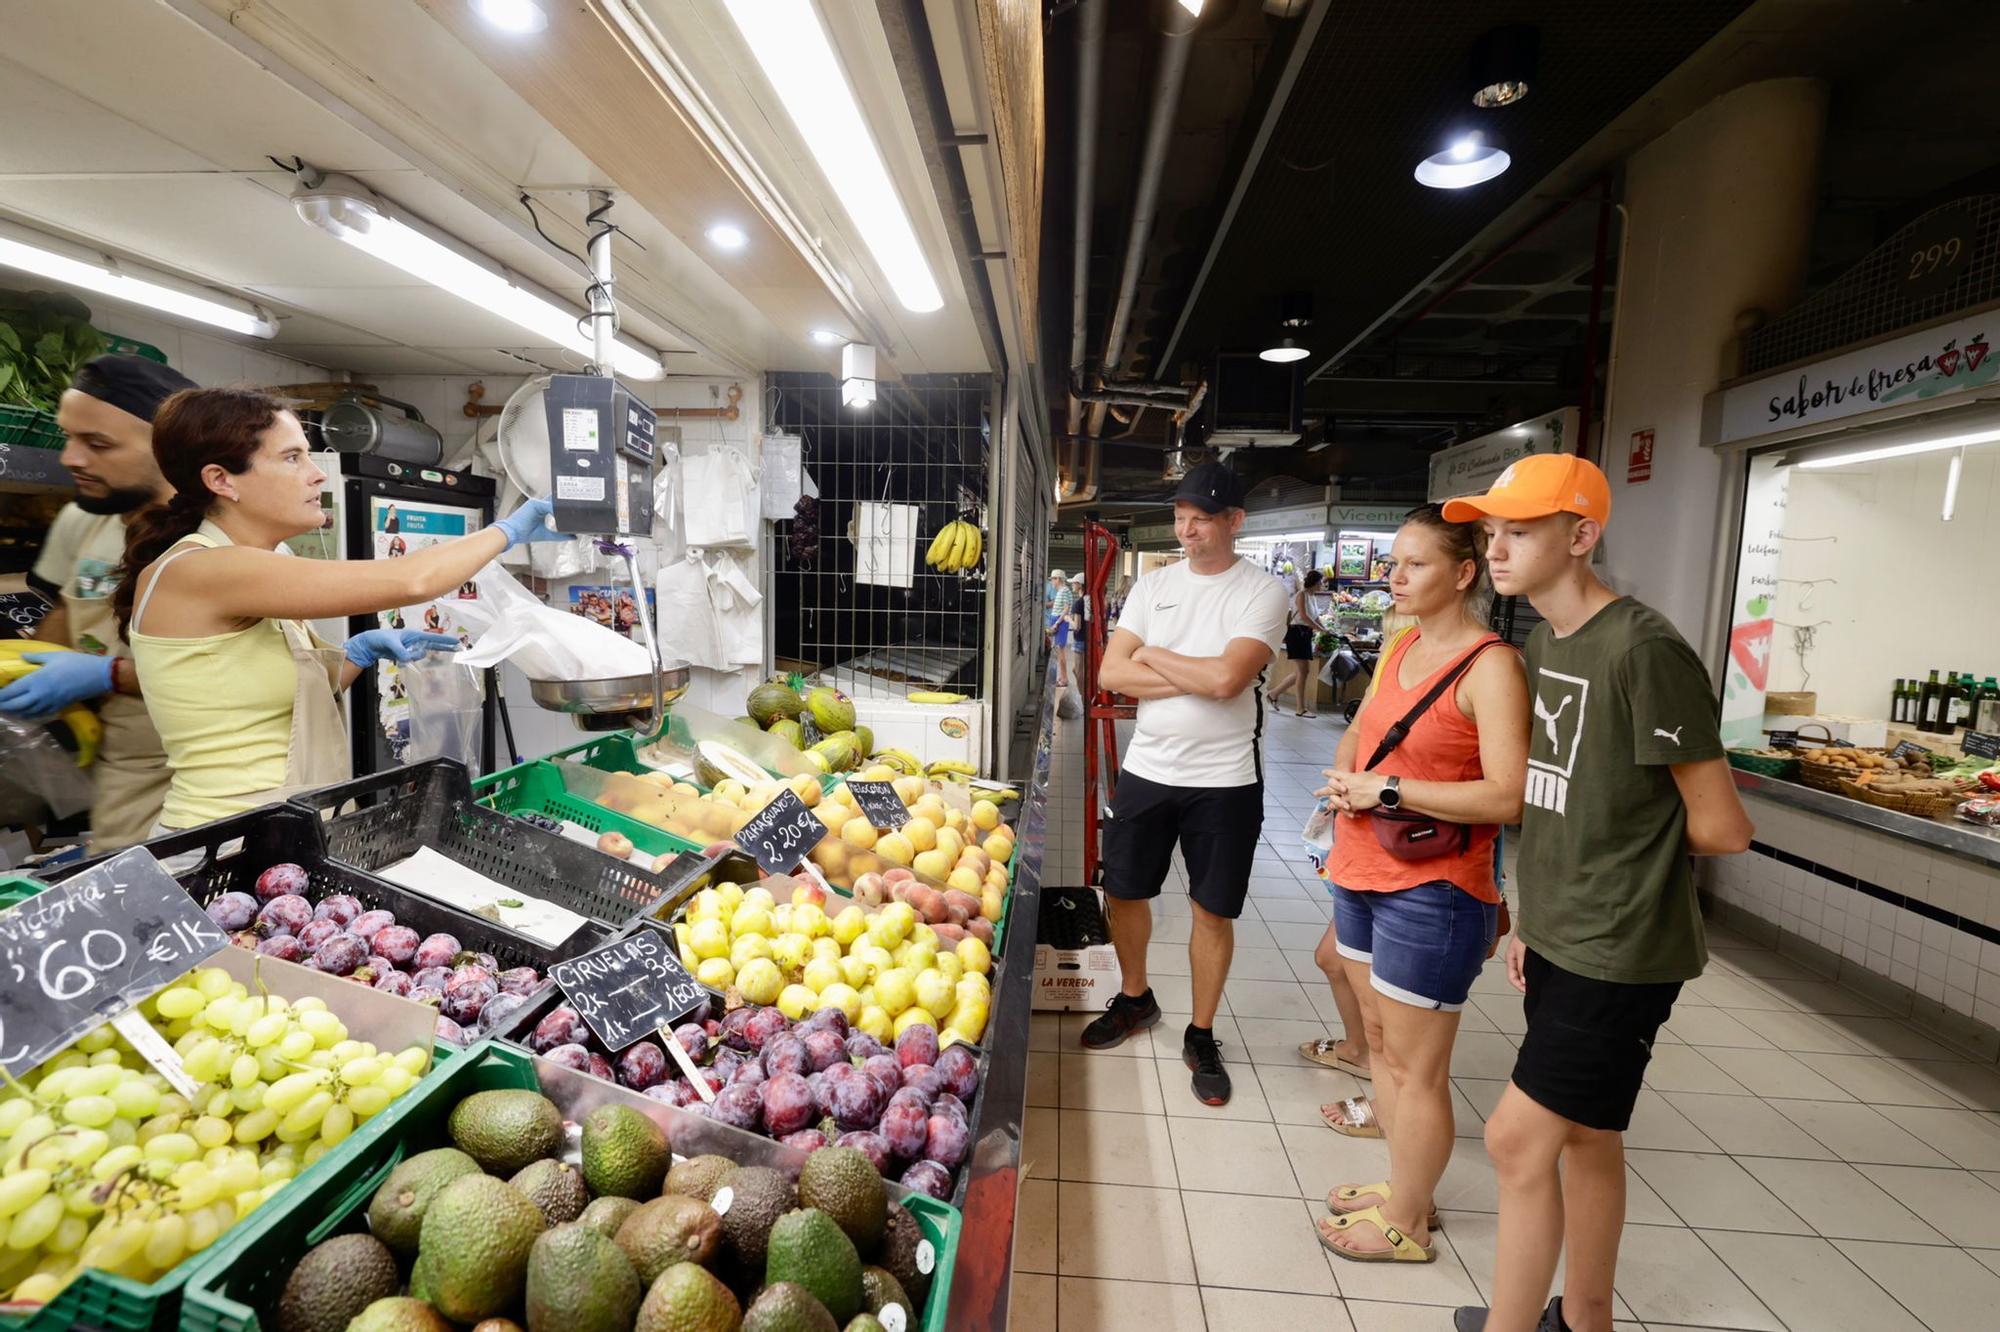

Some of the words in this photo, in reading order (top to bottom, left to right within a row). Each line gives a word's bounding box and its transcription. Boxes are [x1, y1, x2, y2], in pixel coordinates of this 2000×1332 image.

[1907, 237, 1961, 280] 299
[1768, 374, 1848, 422] Sabor
[1850, 376, 1865, 397] de
[1868, 354, 1937, 401] fresa
[1337, 508, 1406, 522] Vicente
[736, 791, 798, 847] PARAGUAYOS
[644, 954, 678, 979] 3€
[1041, 978, 1054, 987] LA
[1056, 977, 1095, 988] VEREDA
